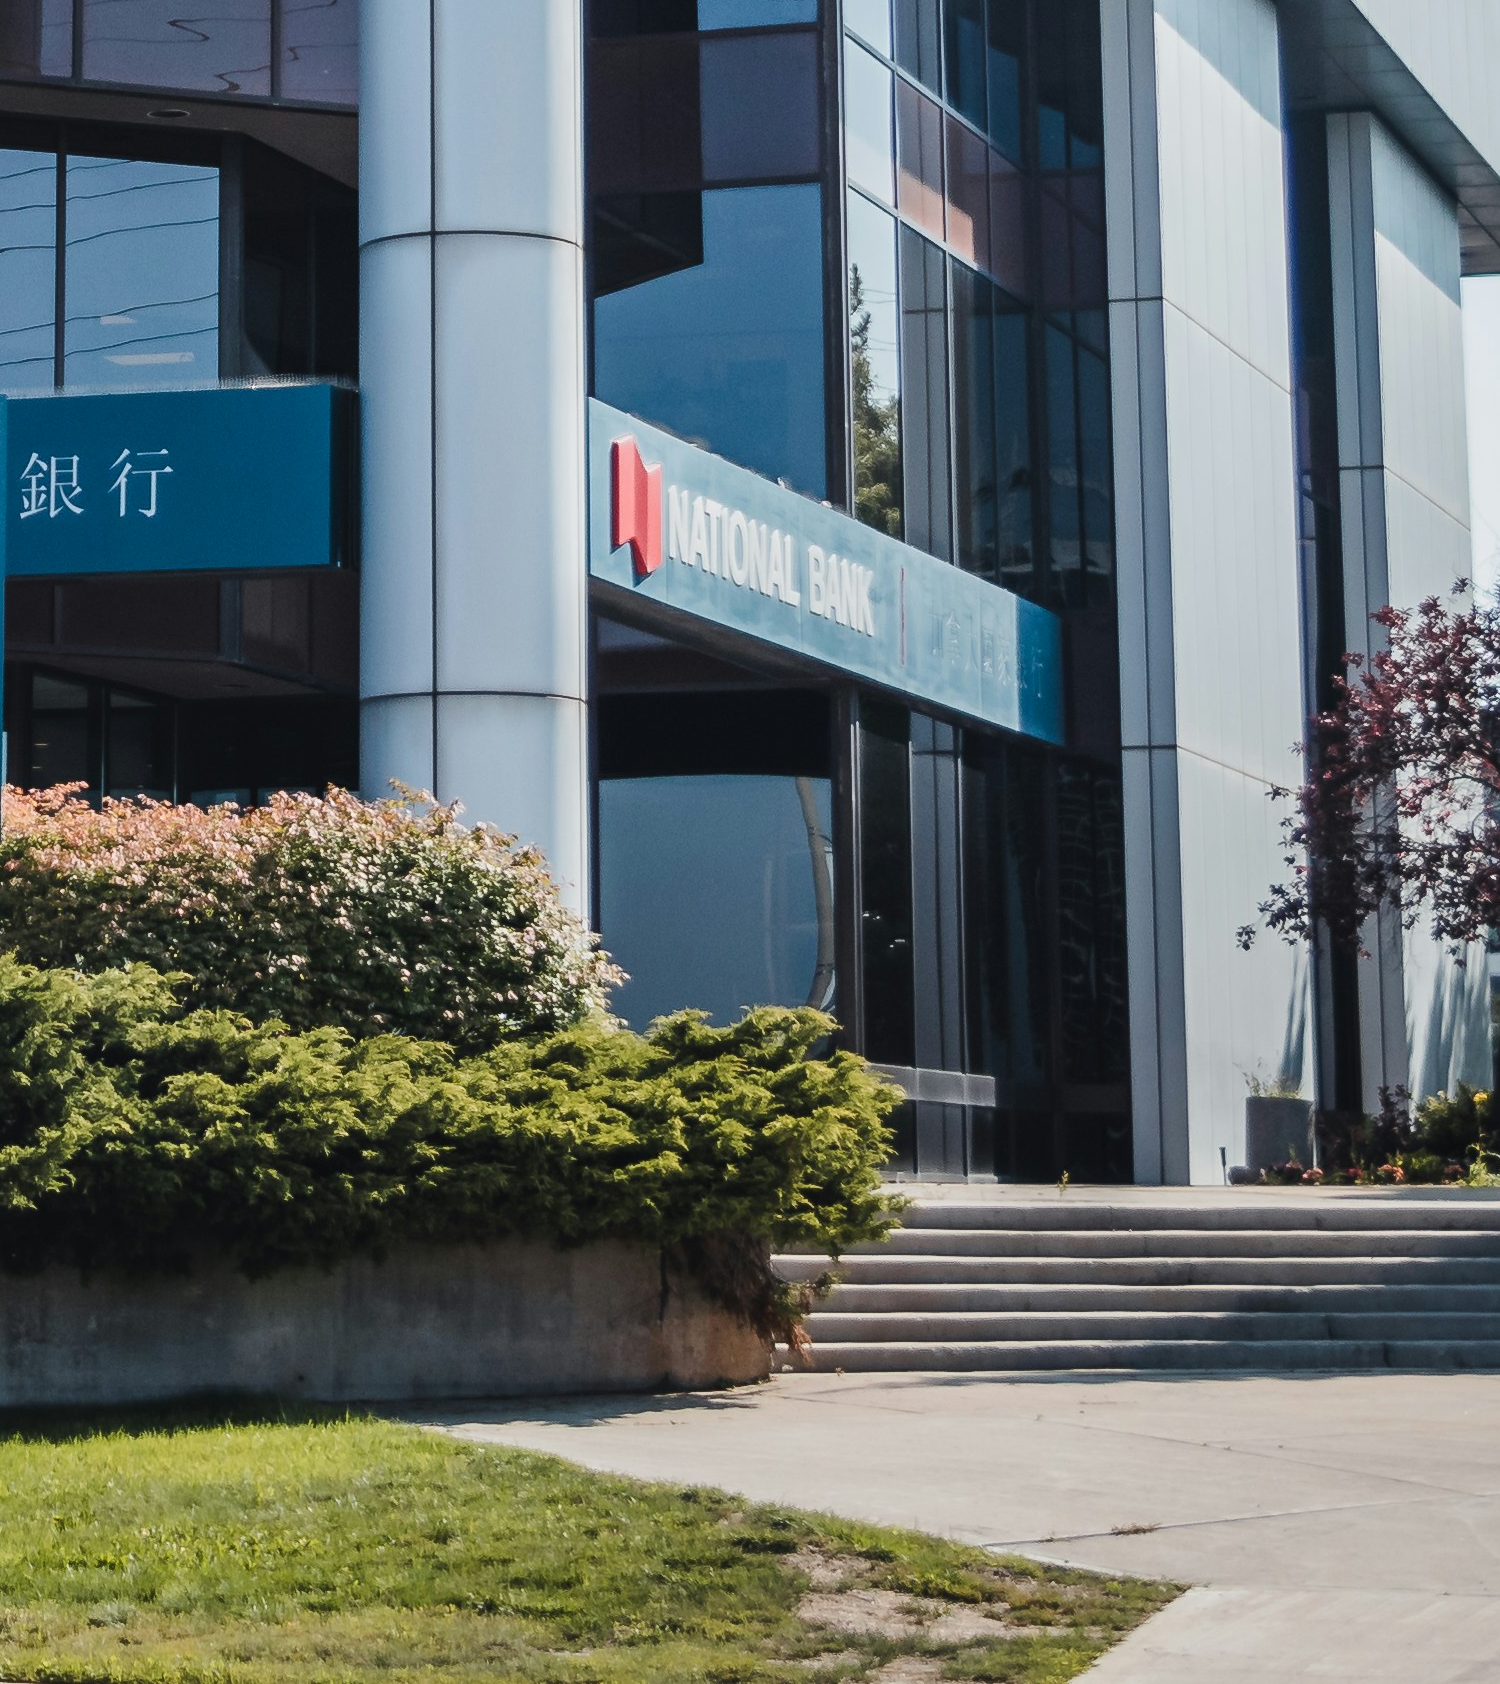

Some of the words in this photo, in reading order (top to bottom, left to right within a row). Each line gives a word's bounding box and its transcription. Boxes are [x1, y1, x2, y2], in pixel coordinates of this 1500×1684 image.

[19, 447, 175, 519] 銀行
[668, 484, 800, 607] NATIONAL
[807, 544, 875, 637] BANK
